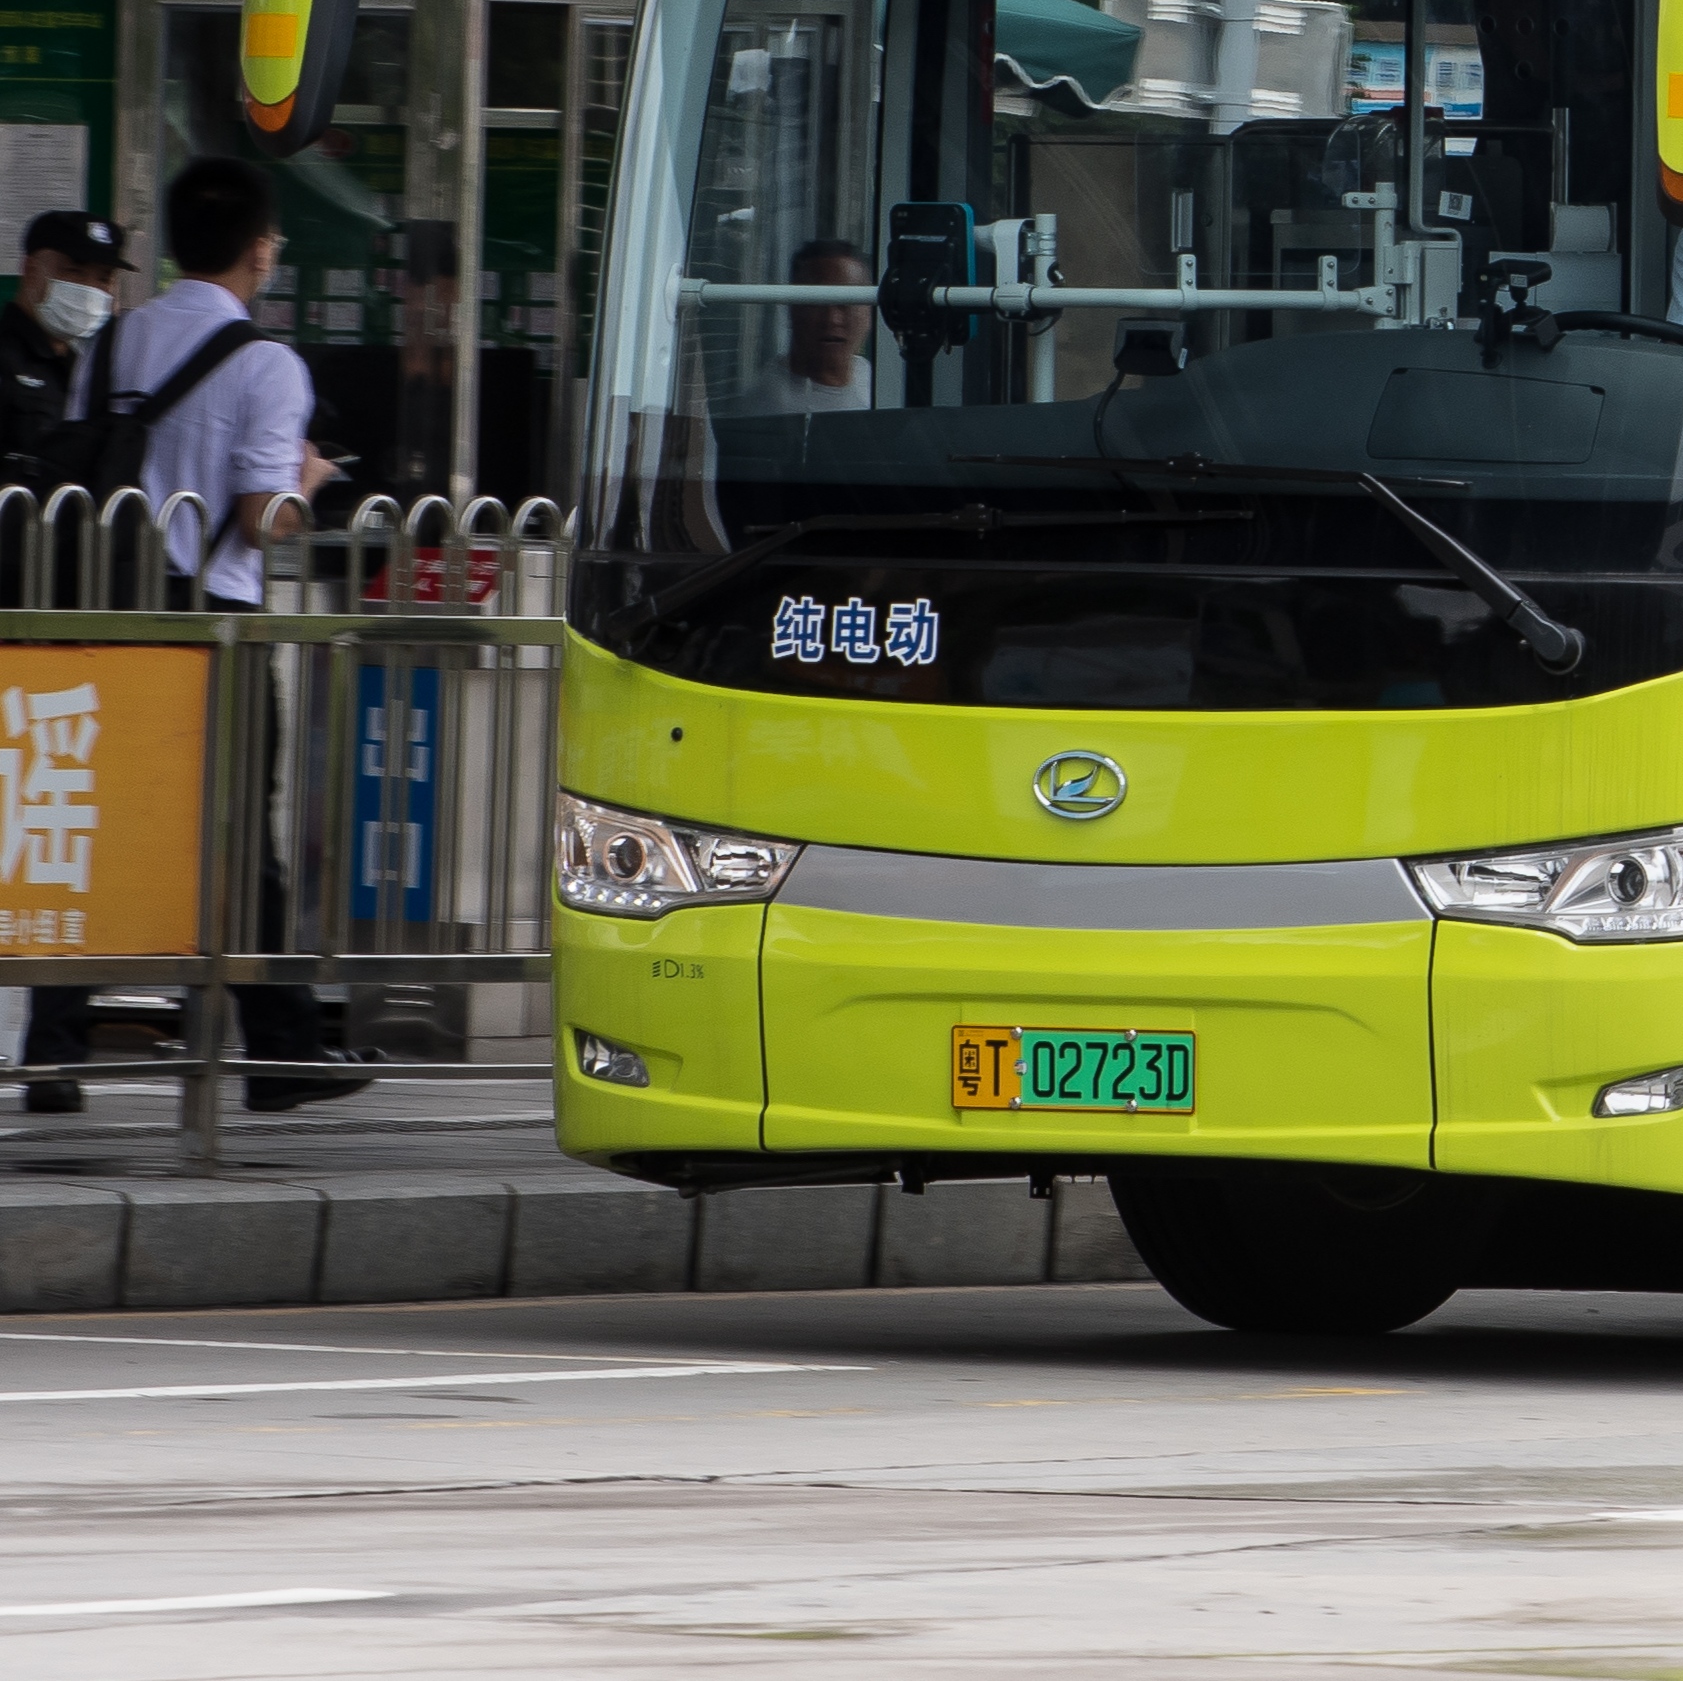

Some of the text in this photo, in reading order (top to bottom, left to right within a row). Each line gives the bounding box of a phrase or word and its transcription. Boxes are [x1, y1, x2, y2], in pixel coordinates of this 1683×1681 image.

[771, 595, 940, 667] 纯电动
[360, 702, 434, 890] 出口
[1032, 1041, 1190, 1101] 02723D
